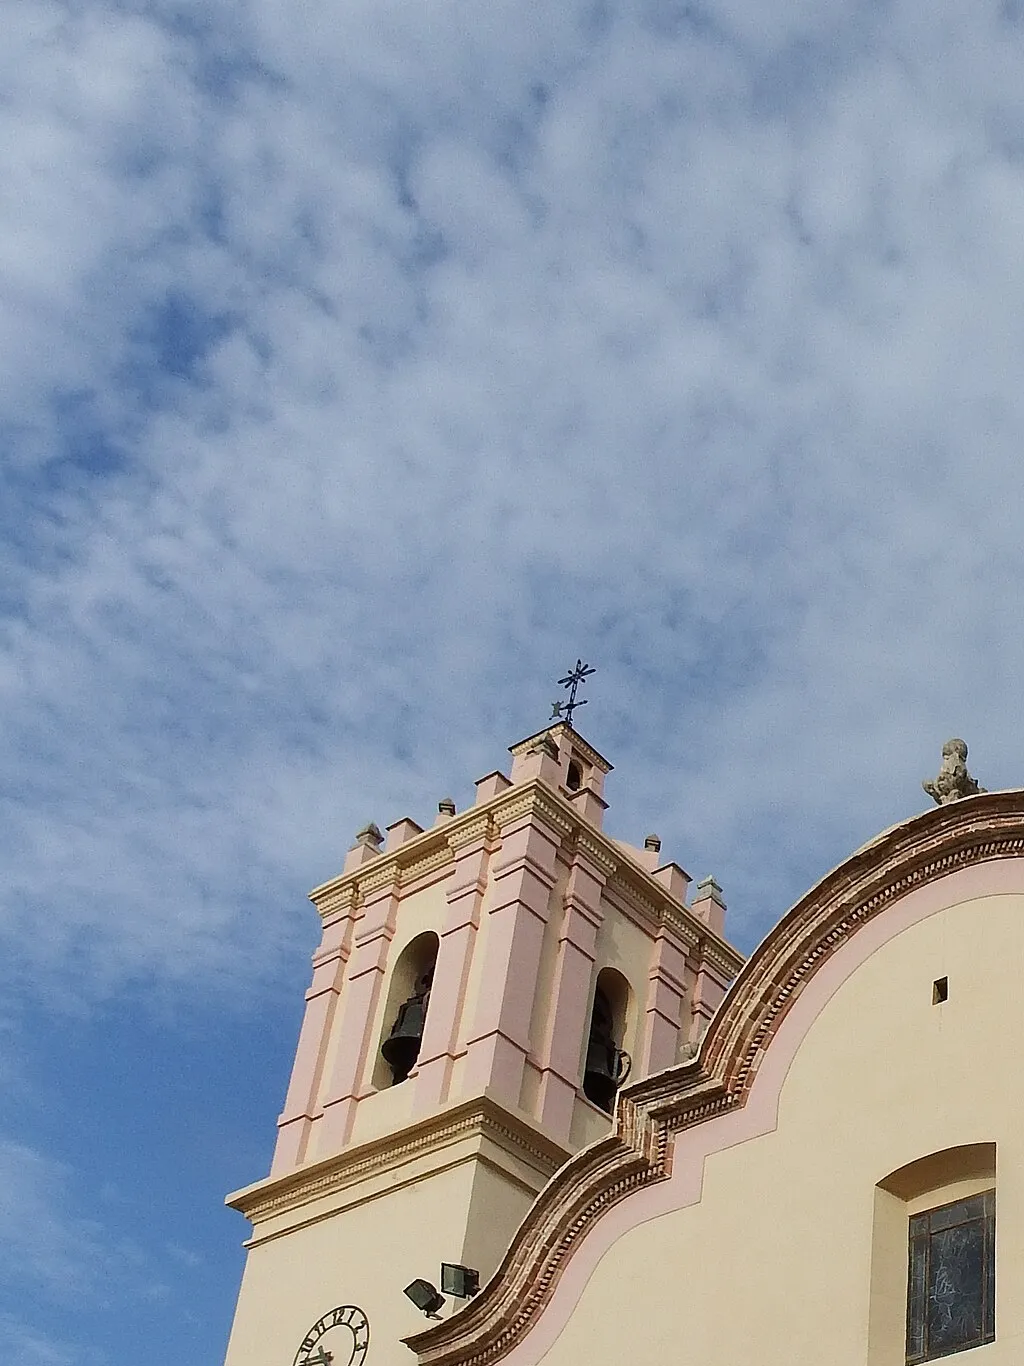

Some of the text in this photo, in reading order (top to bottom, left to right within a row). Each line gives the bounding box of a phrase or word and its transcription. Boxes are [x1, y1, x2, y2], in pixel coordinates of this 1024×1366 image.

[332, 1308, 345, 1323] 12
[348, 1309, 356, 1323] 1
[315, 1320, 326, 1335] 11
[355, 1320, 367, 1333] 2
[301, 1338, 315, 1352] 10
[356, 1342, 367, 1351] 3
